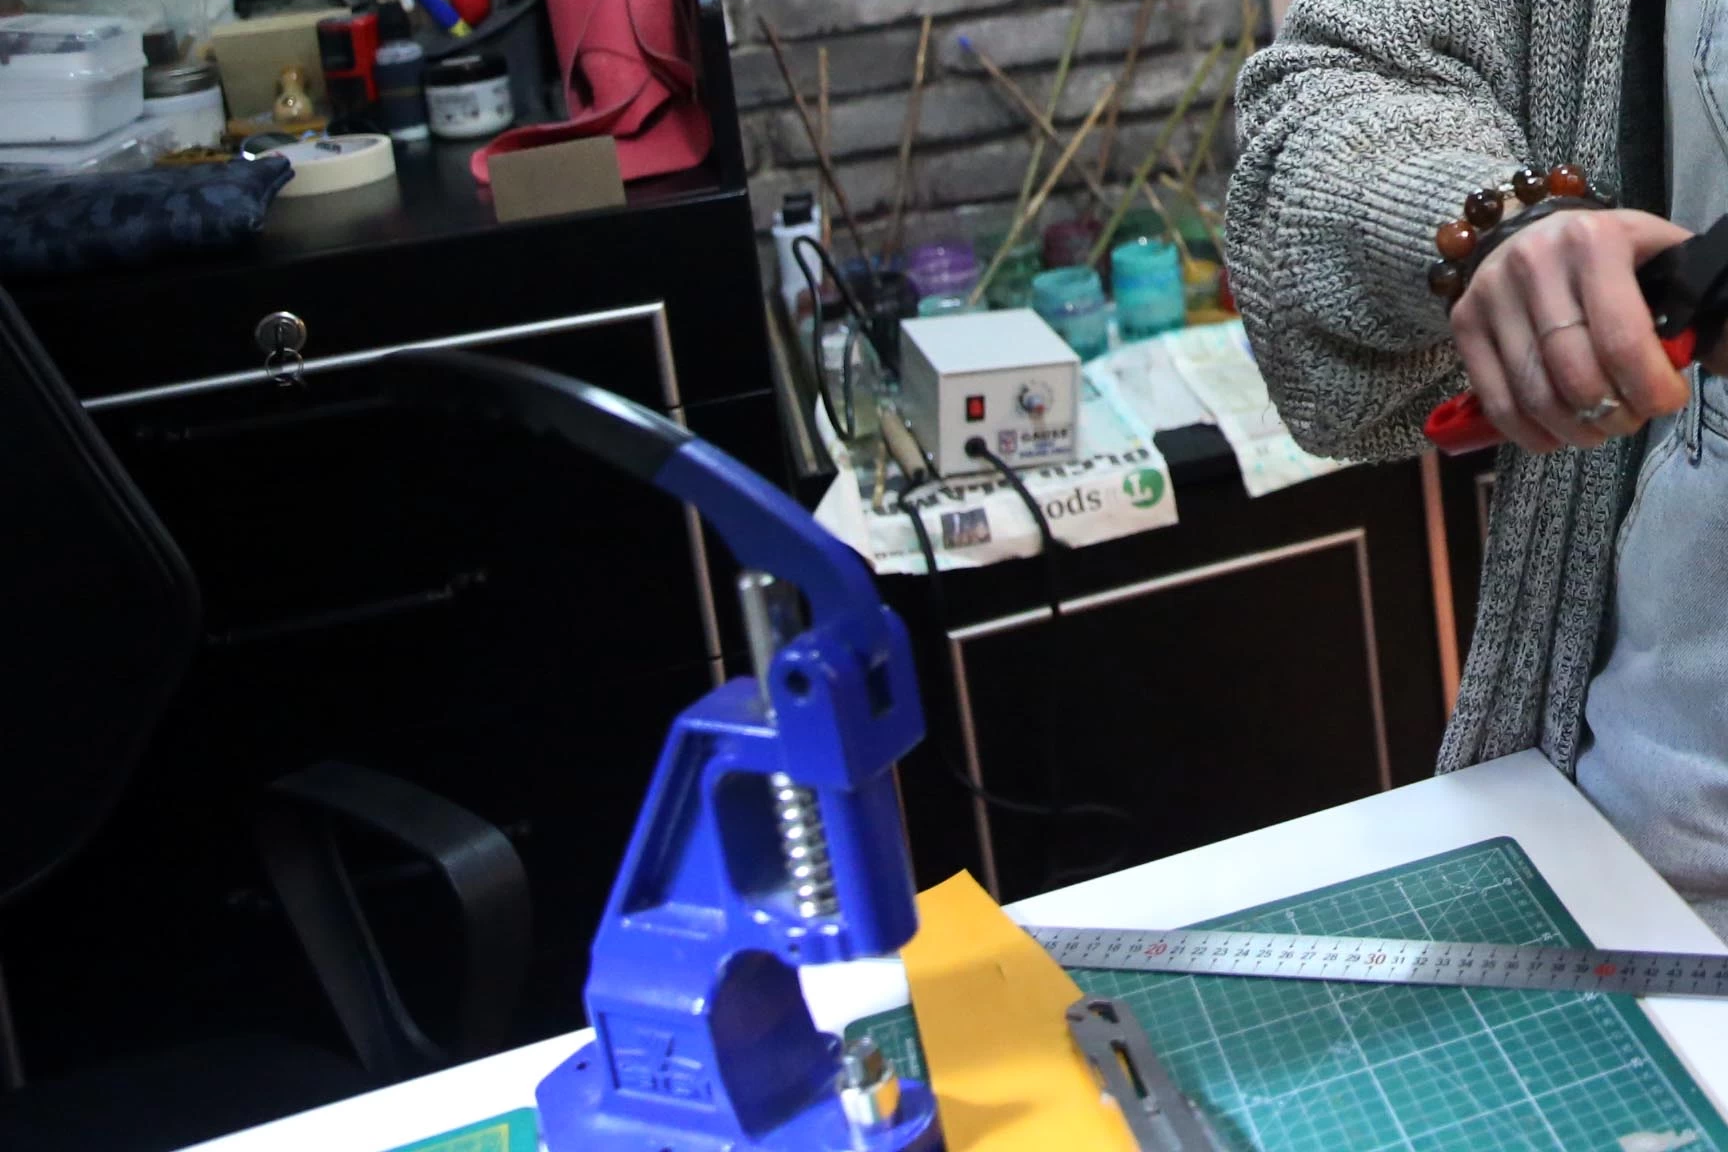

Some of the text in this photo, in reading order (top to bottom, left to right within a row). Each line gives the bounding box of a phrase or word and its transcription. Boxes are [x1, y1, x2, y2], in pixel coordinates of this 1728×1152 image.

[1044, 941, 1058, 950] 15
[1065, 942, 1079, 951] 16
[1086, 942, 1101, 951] 17
[1108, 943, 1122, 952] 18
[1129, 944, 1143, 953] 19
[1144, 943, 1168, 955] 20
[1170, 946, 1186, 954] 21
[1191, 946, 1208, 955] 22
[1213, 947, 1228, 956] 23
[1234, 948, 1250, 957] 24
[1256, 949, 1272, 958] 25
[1278, 950, 1295, 959] 26
[1300, 952, 1316, 961] 27
[1323, 952, 1338, 961] 28
[1345, 953, 1361, 962] 29
[1364, 953, 1387, 965] 30
[1391, 956, 1405, 965] 31
[1412, 957, 1428, 966] 32
[1434, 958, 1450, 967] 33
[1458, 959, 1474, 968] 34
[1527, 961, 1544, 971] 37
[1620, 966, 1636, 975] 41
[1666, 968, 1682, 977] 43
